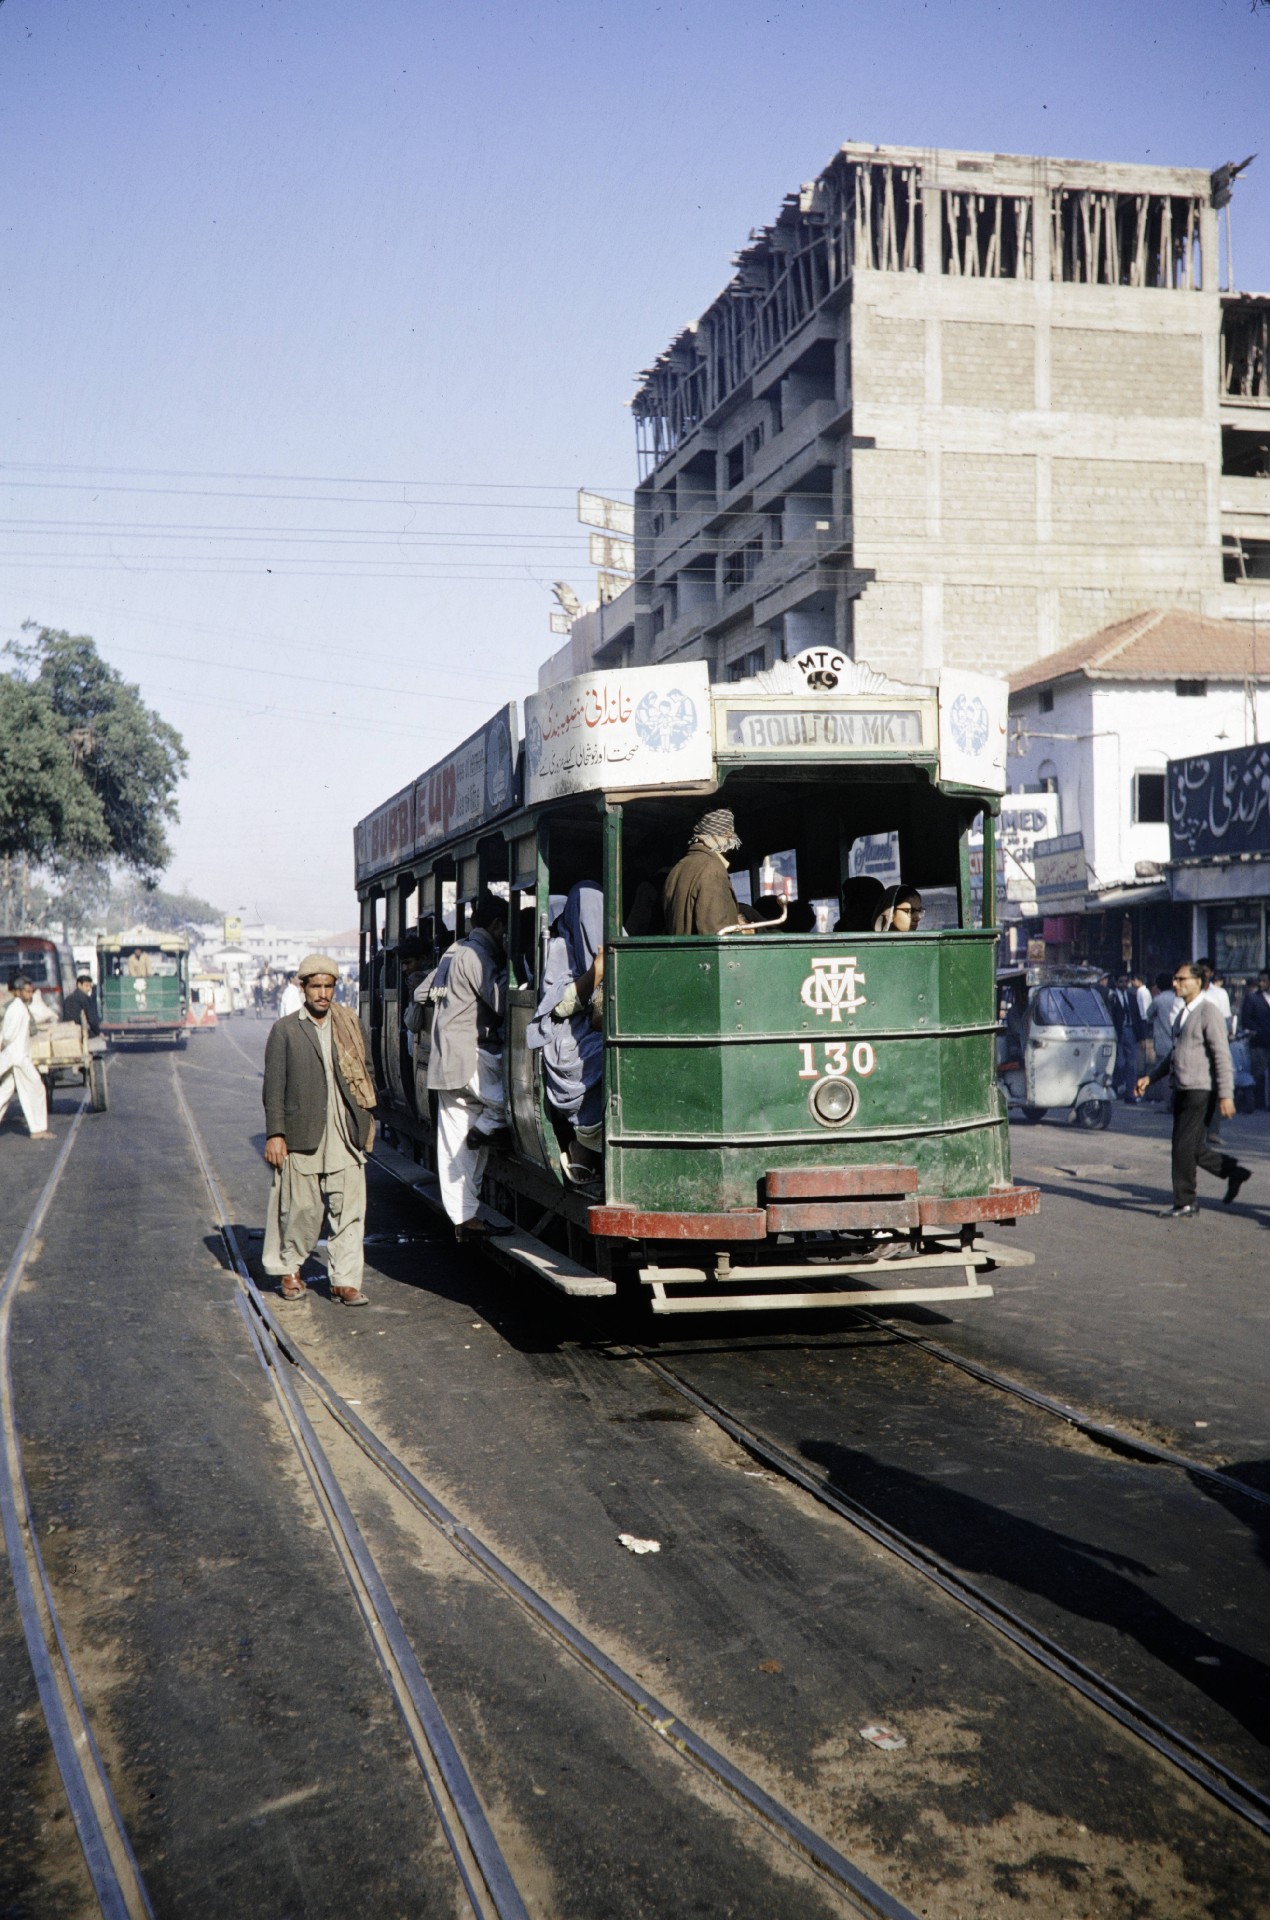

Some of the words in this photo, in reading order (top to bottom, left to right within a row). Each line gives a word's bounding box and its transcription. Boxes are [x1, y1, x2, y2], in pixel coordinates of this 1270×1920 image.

[797, 652, 845, 674] MTC
[585, 683, 632, 728] خاندانی
[751, 713, 855, 747] BOULTON
[798, 1042, 876, 1079] 130
